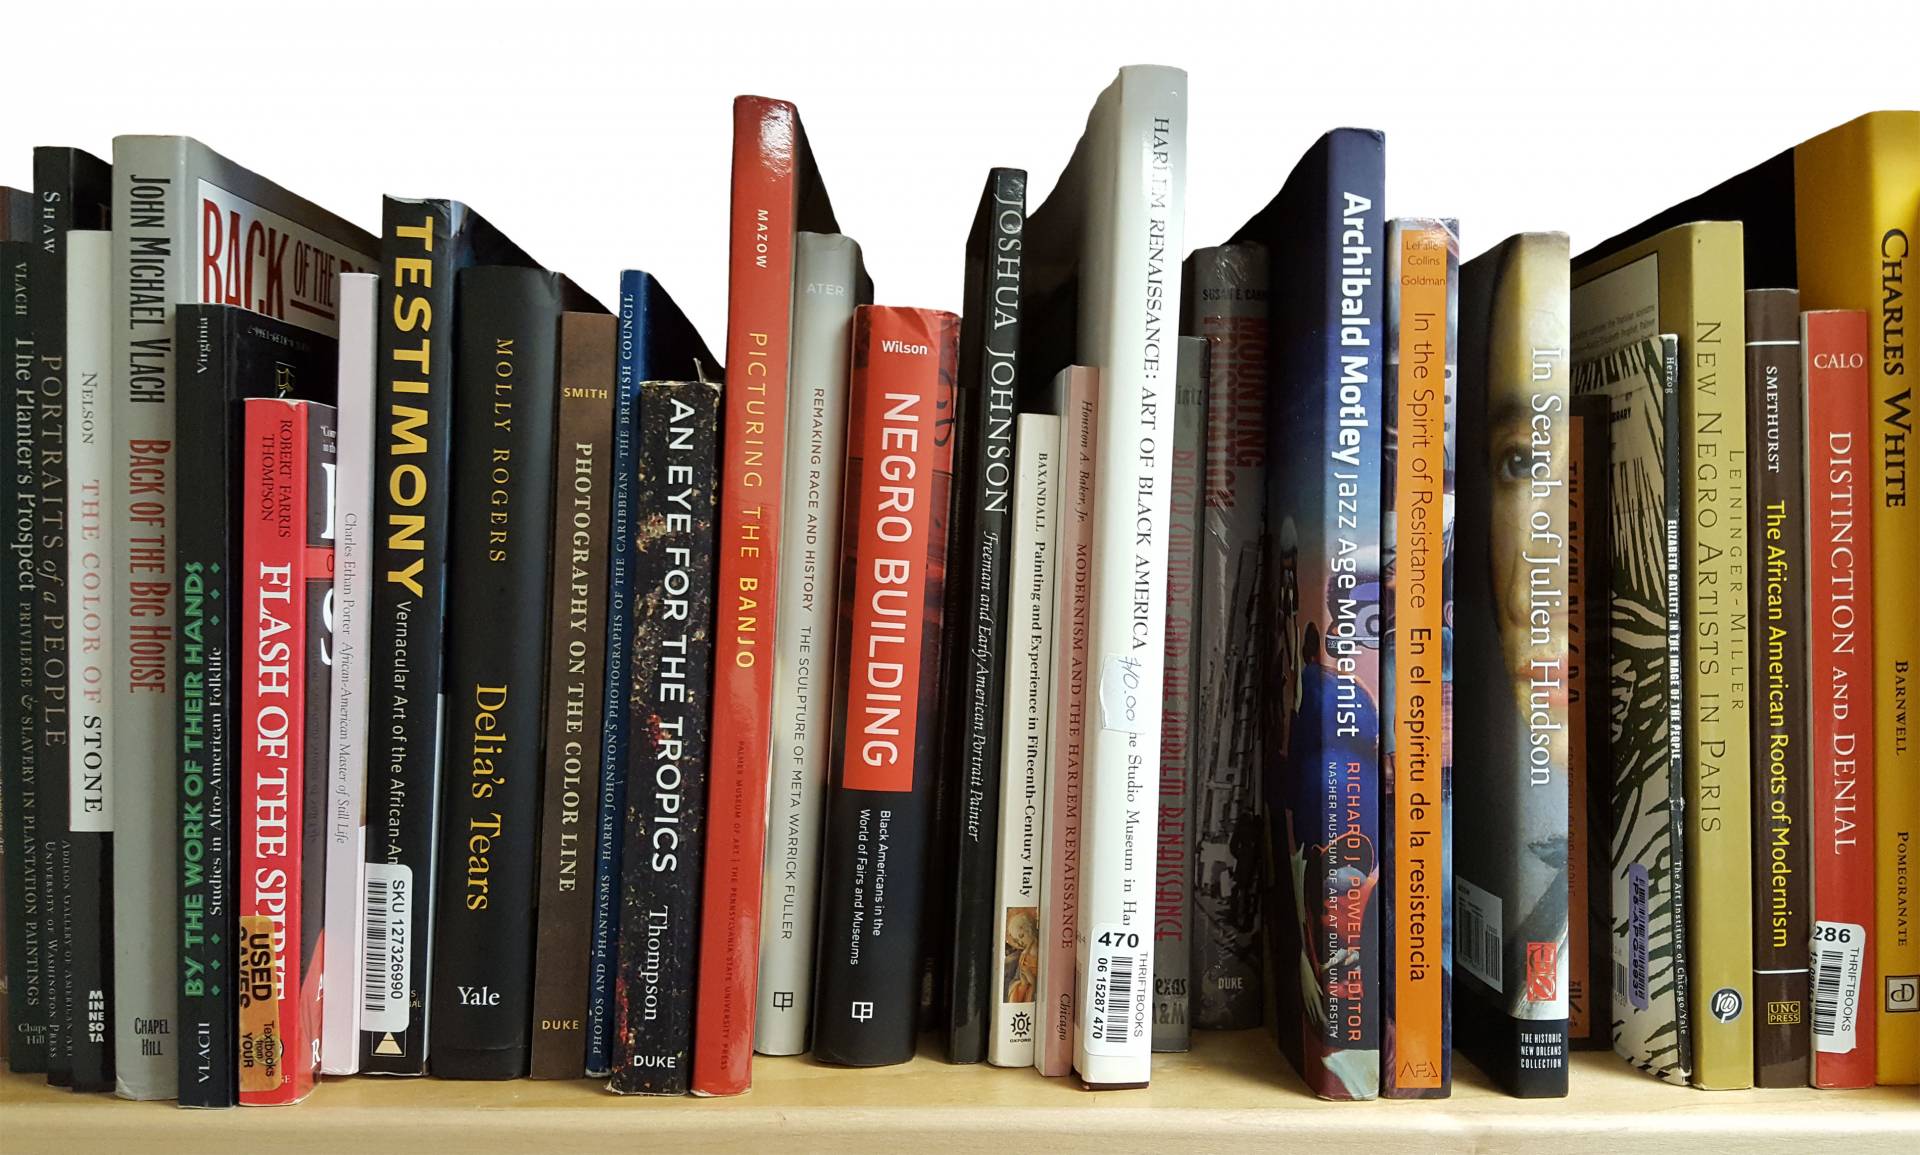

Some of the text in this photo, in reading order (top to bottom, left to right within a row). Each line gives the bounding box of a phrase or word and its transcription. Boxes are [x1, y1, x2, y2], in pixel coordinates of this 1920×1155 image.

[42, 192, 60, 254] SHAW
[756, 209, 769, 269] MAZOW
[1407, 255, 1440, 265] Collins
[129, 174, 171, 403] JOHN MICHAEL VLACH
[314, 248, 335, 307] THE
[806, 283, 845, 297] ATER
[1401, 275, 1446, 286] Goldman
[196, 317, 209, 374] Virginia
[494, 338, 514, 432] MOLLY
[881, 340, 928, 355] Wilson
[1664, 356, 1676, 394] Herzog
[1814, 353, 1864, 369] CALO
[1882, 228, 1912, 508] CHARLES WHITE
[81, 373, 98, 444] NELSON
[388, 215, 433, 598] TESTIMONY
[563, 388, 608, 400] SMITH
[1766, 365, 1780, 473] SMETHURST
[261, 435, 275, 522] THOMPSON
[279, 419, 294, 538] ROBERT FARRIS
[736, 332, 768, 668] PICTURING THE BANJO
[1136, 387, 1157, 546] ART BLACK
[1332, 191, 1371, 737] Archibald Motley Modernist
[40, 355, 66, 747] PORTRAITS PEOPLE
[968, 195, 1024, 842] JOSHUA JOHNSON Painter
[1667, 519, 1678, 571] ELIZABETH
[129, 439, 172, 693] BACK THE BIG HOUSE
[862, 392, 921, 767] NEGRO BUILDING
[1523, 393, 1563, 787] Search of Julien Hudson
[1729, 450, 1746, 710] LEININGER-MILLER
[339, 513, 358, 740] Charles Porter African-American
[651, 398, 696, 872] AN EYE FOR THE TROPICS
[781, 388, 825, 940] REMAKING RACE AND HISTORY THE SCULPTURE META FULLER
[1697, 411, 1726, 832] NEGRO ARTISTS PARIS
[1829, 431, 1857, 855] DISTINCTION AND DENIAL
[82, 552, 103, 813] COLOR STONE
[256, 561, 292, 858] FLASH OF THE
[391, 600, 412, 773] Vernacular Art of the
[559, 442, 593, 893] PHOTOGRAPHY THE COLOR LINE
[1019, 452, 1049, 897] BAXANDALL Painting and Italy
[1895, 660, 1909, 755] BARNWELL
[11, 493, 40, 1006] Prospect SLAVERY PLANTATION PAINTINGS
[184, 562, 204, 948] THE WORK THEIR HANDS
[1062, 544, 1088, 949] MODERNISM AND THE HARLEM RENAISSANCE
[1126, 754, 1142, 802] Studio
[1409, 490, 1433, 981] Resistance resistencia
[1767, 545, 1793, 947] African American Roots Modernism
[207, 647, 223, 916] Studies Afro-American Folklife
[466, 684, 508, 911] Delia's Tears
[1328, 761, 1338, 809] NASHER
[873, 810, 892, 903] Black Americans
[1124, 809, 1140, 872] Museum
[598, 875, 612, 957] PHANTASMS
[850, 809, 872, 965] World Fairs Museums
[1346, 762, 1362, 1041] RICHARD EDITOR
[1898, 831, 1909, 946] POMEGRANATE
[250, 933, 273, 1000] USED
[390, 880, 405, 999] SKU 127326990
[640, 905, 669, 1021] Thompson
[1097, 931, 1140, 948] 470
[1218, 977, 1243, 990] DUKE
[134, 1017, 170, 1034] CHAPEL
[456, 986, 501, 1006] Yale
[541, 1019, 580, 1030] DUKE
[1056, 993, 1071, 1041] Chicago
[1092, 977, 1107, 1040] 15287 470
[1133, 952, 1149, 1038] THRIFTBOOKS
[1675, 967, 1688, 1035] Chicago/Yale
[1770, 1003, 1798, 1013] UNC
[1770, 1014, 1799, 1022] PRESS
[1841, 947, 1860, 1032] THRIFTBOOKS
[142, 1039, 163, 1056] HILL
[242, 1032, 253, 1068] YOUR
[264, 1020, 275, 1077] Textbooks
[633, 1055, 676, 1069] DUKE
[1520, 1059, 1562, 1069] COLLECTION
[1521, 1033, 1533, 1043] THE
[1534, 1033, 1562, 1043] HISTORIC
[1536, 1046, 1562, 1056] ORLEANS
